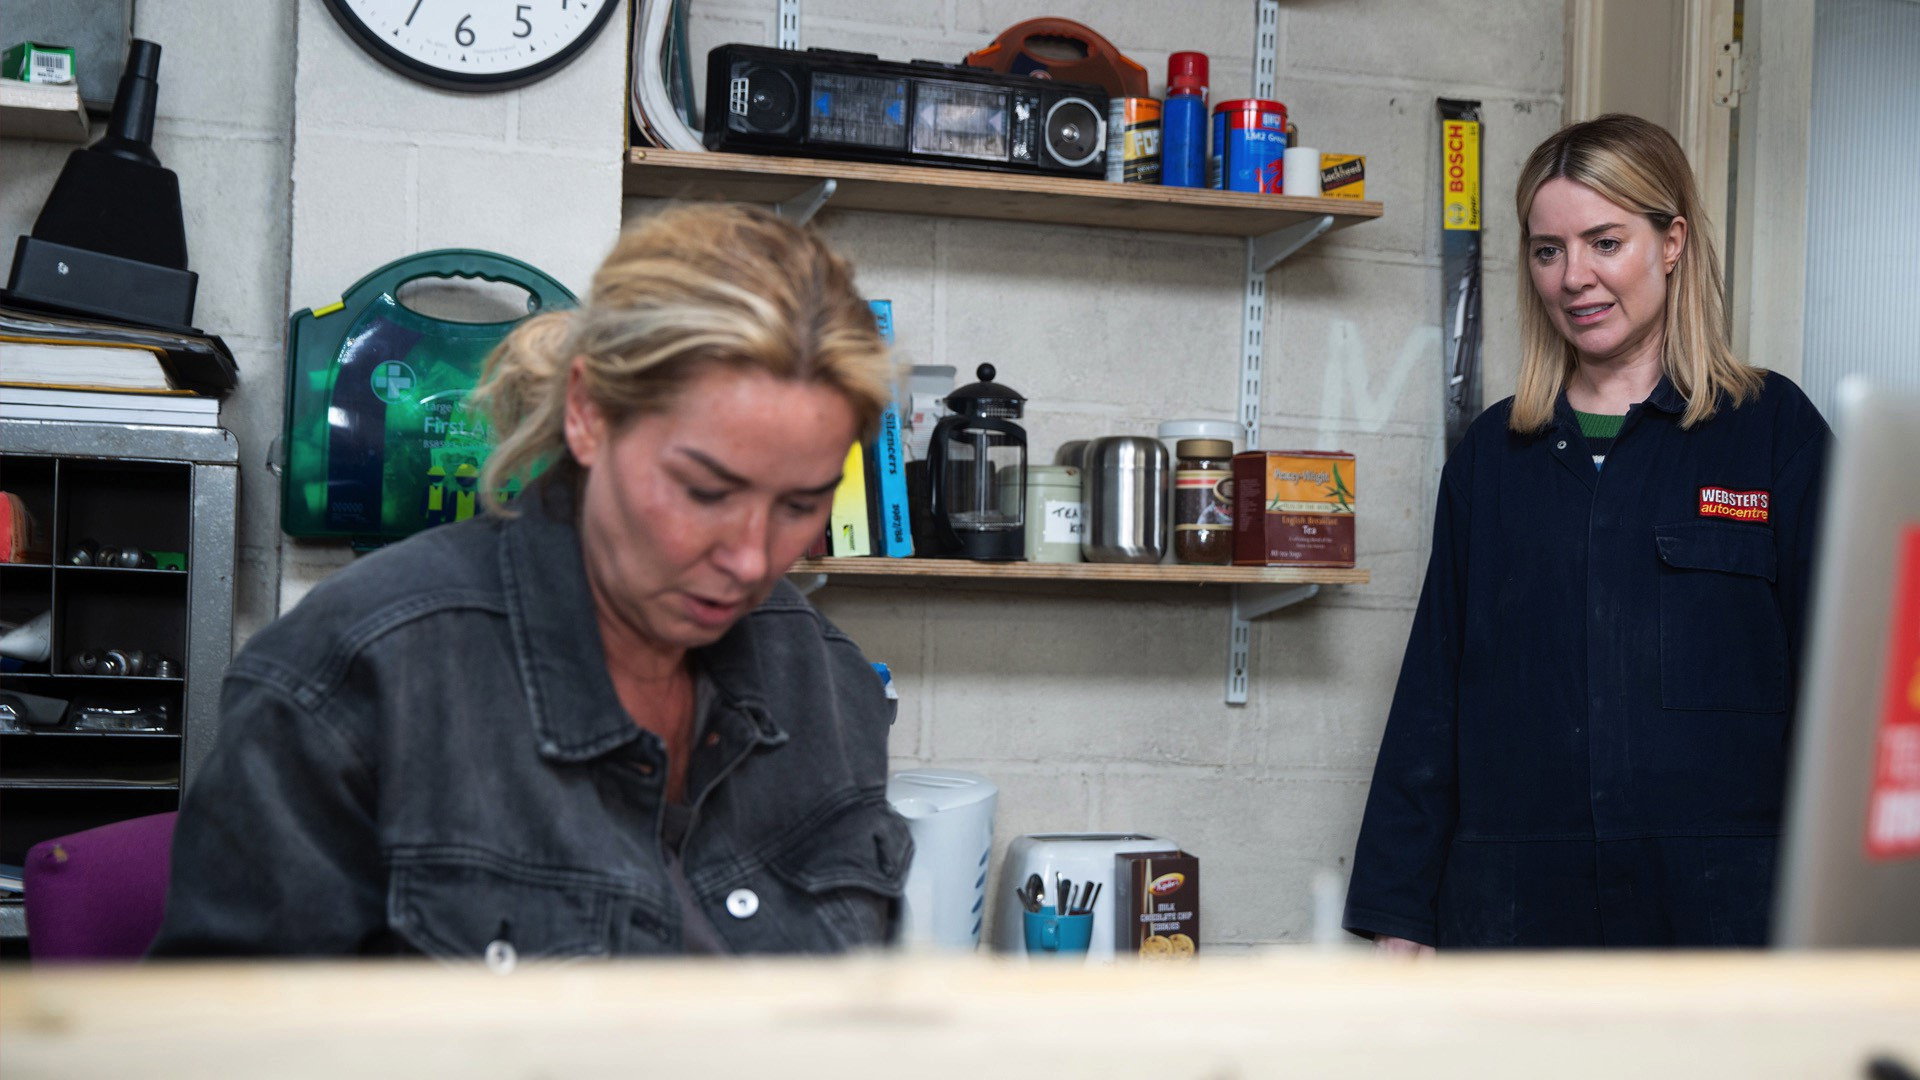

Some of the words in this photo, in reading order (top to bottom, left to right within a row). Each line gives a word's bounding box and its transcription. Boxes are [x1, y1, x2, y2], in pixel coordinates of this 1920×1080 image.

[512, 5, 532, 38] 5
[455, 14, 476, 46] 6
[1449, 125, 1464, 192] BOSCH
[425, 403, 452, 415] Large
[424, 417, 466, 434] First
[884, 412, 898, 475] Silencers
[1702, 488, 1768, 508] WEBSTER'S
[1052, 507, 1079, 519] TEA
[1701, 504, 1768, 519] autocentre
[1282, 516, 1306, 526] English
[1307, 516, 1338, 525] Breakfast
[1302, 524, 1317, 535] Tea
[1158, 903, 1175, 911] MILK
[1140, 912, 1177, 922] CHOCOLATE
[1178, 911, 1193, 920] CHIP
